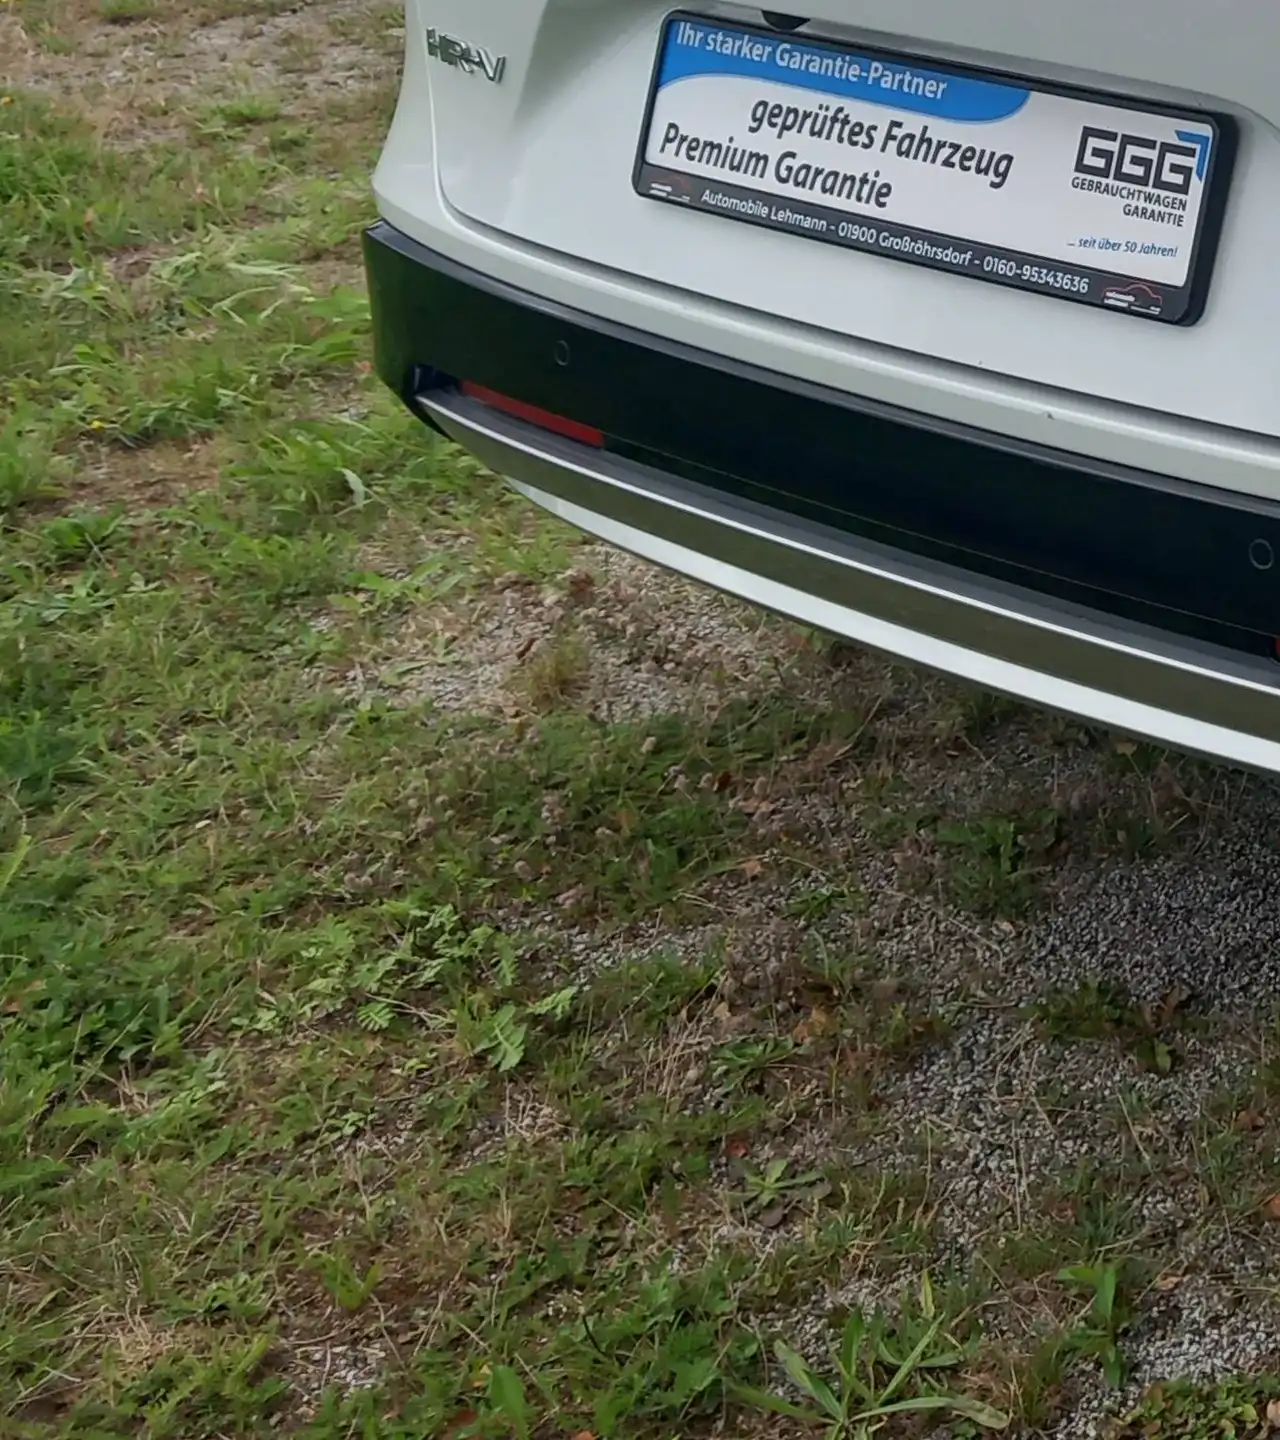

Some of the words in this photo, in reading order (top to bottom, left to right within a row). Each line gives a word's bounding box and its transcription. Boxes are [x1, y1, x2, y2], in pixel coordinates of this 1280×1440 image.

[677, 22, 702, 47] Ihr
[706, 31, 772, 62] starker
[775, 43, 947, 99] Garantie-Partner
[659, 122, 770, 179] Premium
[774, 151, 892, 208] Garantie
[748, 100, 878, 150] geprüftes
[880, 120, 1015, 189] Fahrzeug
[1074, 125, 1197, 195] GGG
[1071, 176, 1187, 211] GEBRAUCHTWAGEN
[1122, 203, 1185, 228] GARANTIE
[701, 188, 769, 218] Automobile
[770, 208, 827, 232] Lehmann
[838, 221, 877, 244] 01900
[878, 230, 972, 267] Großröhrsdorf
[982, 255, 1090, 294] 0160-95343636
[1077, 237, 1096, 250] seit
[1098, 238, 1122, 252] über
[1124, 240, 1138, 253] 50
[1137, 242, 1178, 258] Jahren!
